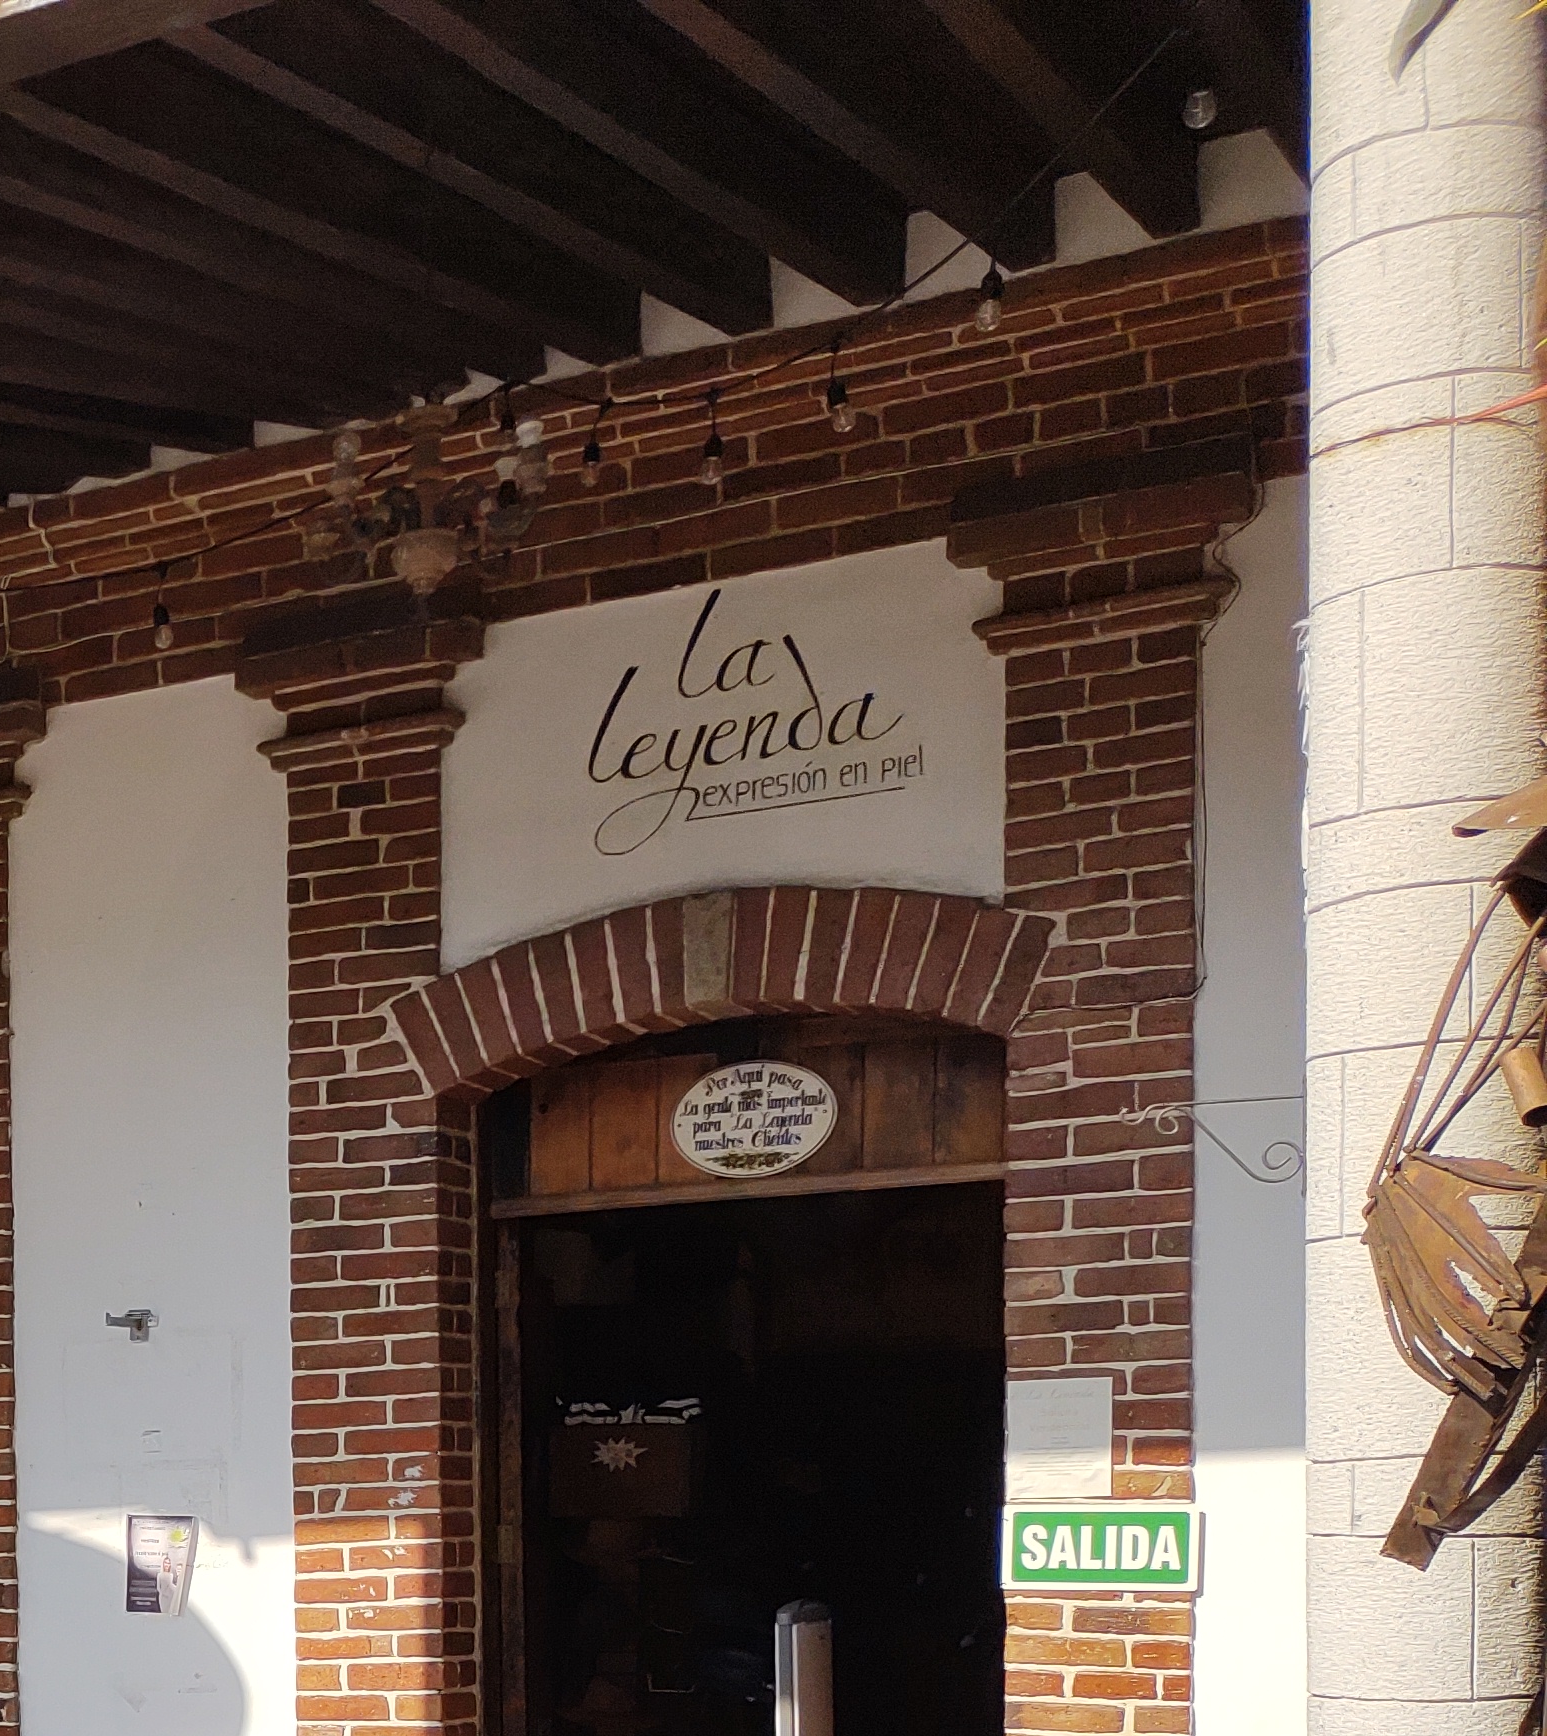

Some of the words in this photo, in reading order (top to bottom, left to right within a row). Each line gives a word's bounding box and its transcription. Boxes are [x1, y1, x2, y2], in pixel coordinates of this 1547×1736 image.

[702, 760, 827, 808] expresión
[839, 760, 868, 788] en
[881, 743, 925, 783] piel
[767, 1070, 804, 1091] pasa
[767, 1087, 827, 1113] importante
[692, 1119, 722, 1139] para
[1020, 1524, 1182, 1571] SALIDA
